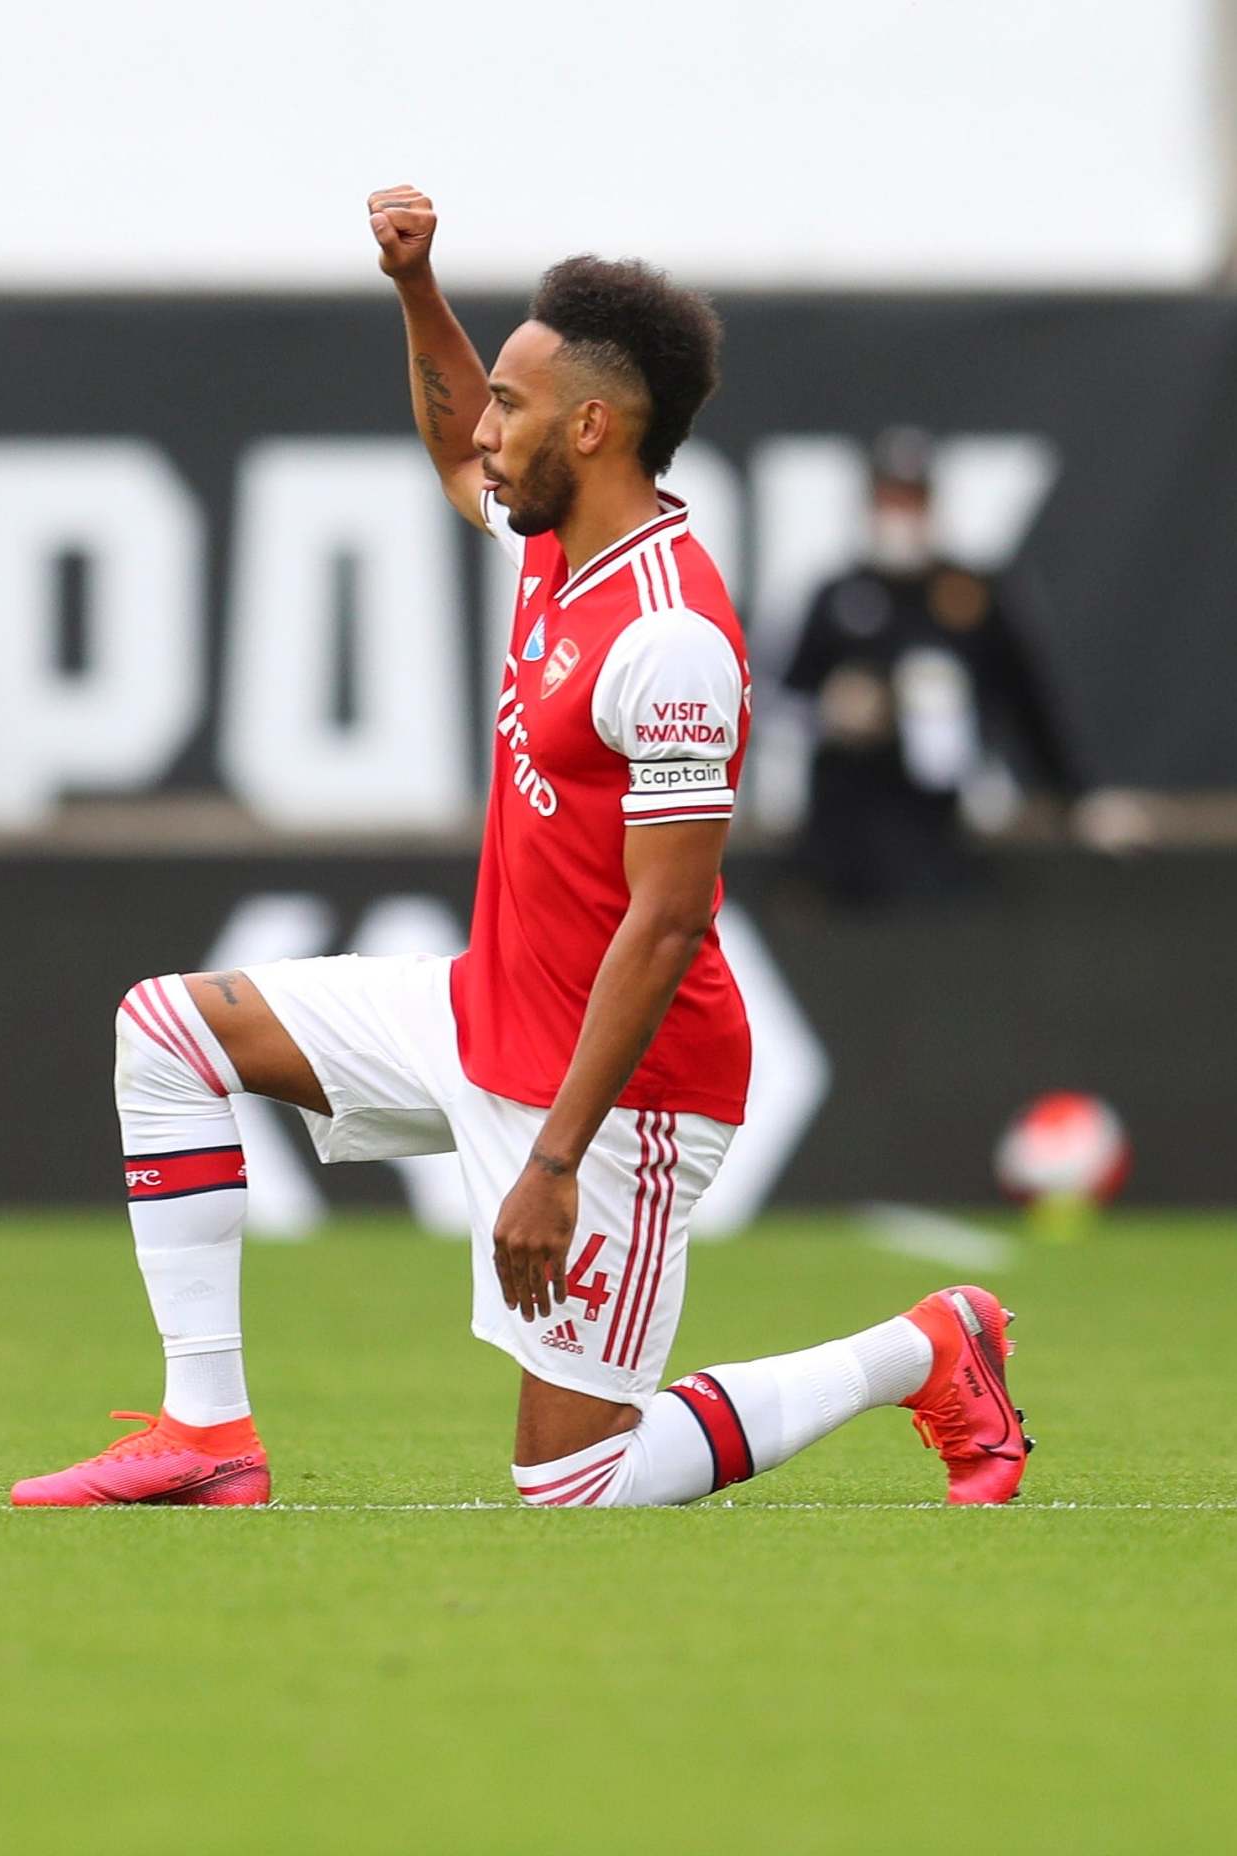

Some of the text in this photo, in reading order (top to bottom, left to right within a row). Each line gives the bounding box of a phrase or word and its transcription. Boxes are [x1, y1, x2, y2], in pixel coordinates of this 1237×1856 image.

[652, 703, 708, 721] VISIT
[635, 724, 726, 744] RWANDA
[640, 763, 721, 787] Captain
[540, 1334, 585, 1356] adidas
